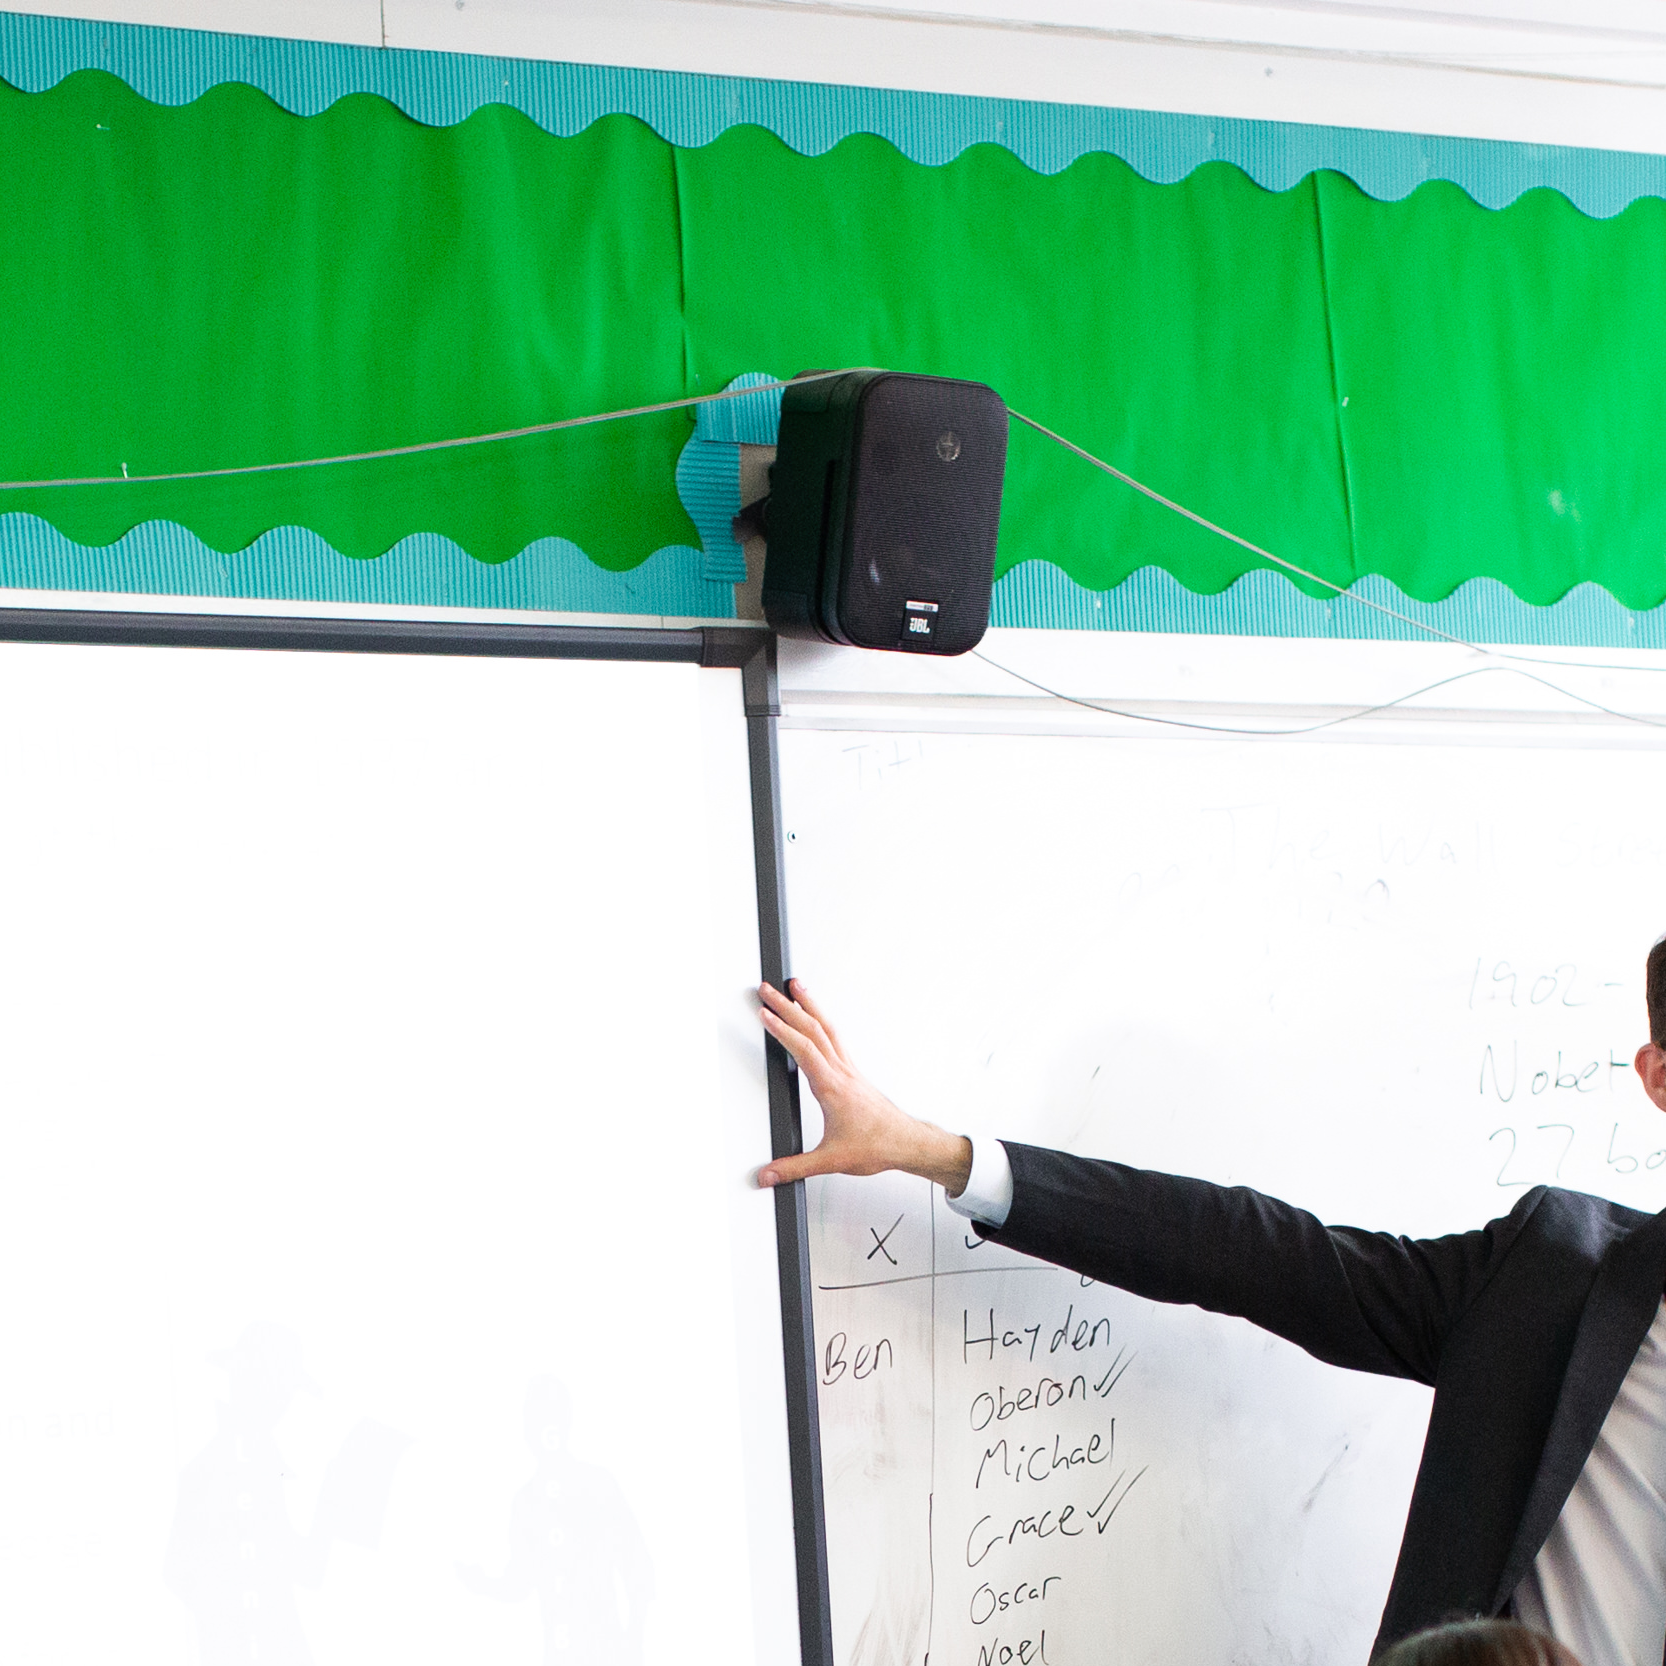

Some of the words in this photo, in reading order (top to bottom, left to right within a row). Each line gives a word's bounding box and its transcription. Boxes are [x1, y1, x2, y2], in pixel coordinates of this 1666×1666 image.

[909, 617, 931, 634] JBL
[1489, 1123, 1575, 1187] 27
[822, 1331, 894, 1386] Ben
[962, 1308, 1112, 1364] Hayden
[969, 1374, 1087, 1433] Oberon
[975, 1417, 1116, 1489] Michael
[966, 1509, 1085, 1568] Grace
[969, 1572, 1063, 1625] Oscar
